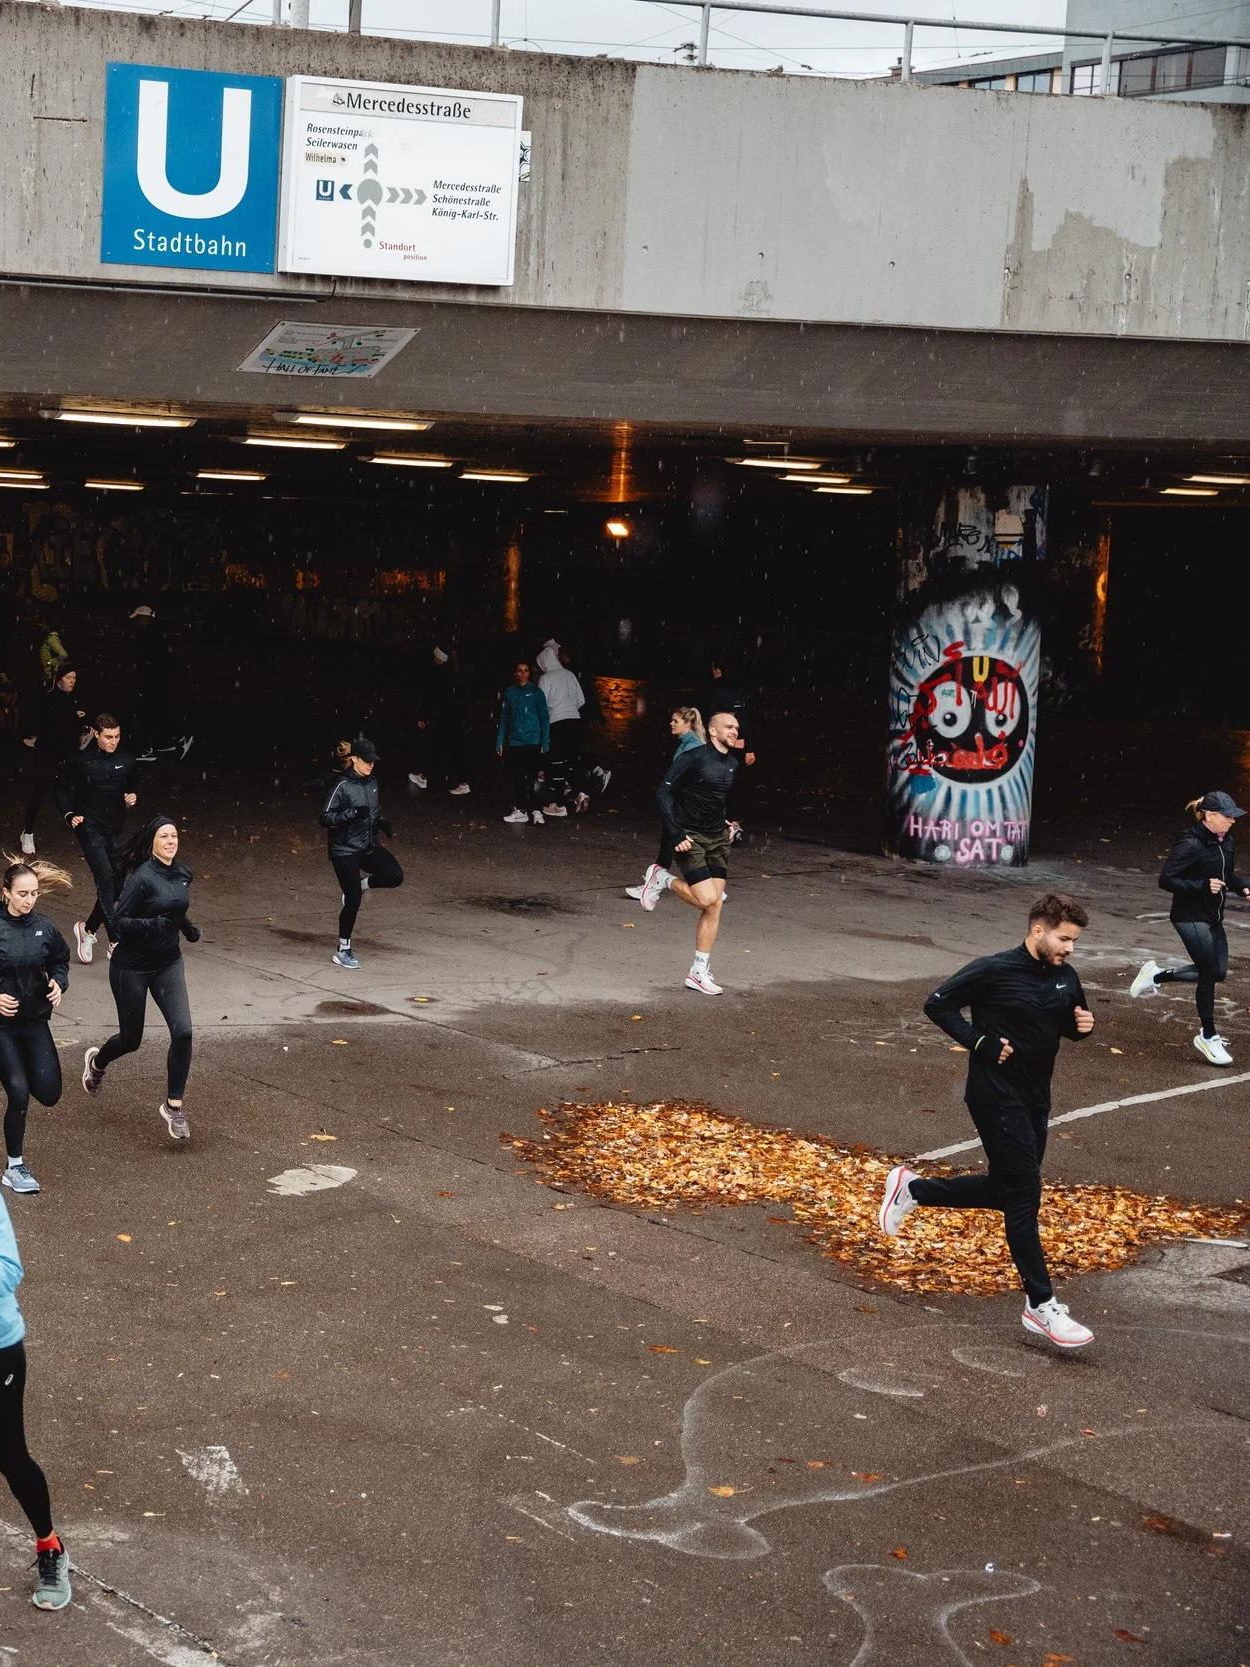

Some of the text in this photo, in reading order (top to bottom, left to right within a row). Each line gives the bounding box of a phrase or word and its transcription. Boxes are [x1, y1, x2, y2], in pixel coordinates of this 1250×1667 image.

[347, 92, 471, 119] Mercedesstraße
[137, 80, 252, 219] U
[306, 137, 358, 150] Seilerwasen
[305, 152, 337, 163] Wilhelma
[318, 180, 332, 197] U
[433, 180, 502, 194] Mercedesstraße
[432, 194, 491, 207] Schönestraße
[432, 207, 499, 221] König-Karl-Str.
[133, 228, 247, 257] Stadtbahn
[379, 241, 416, 252] Standort
[909, 815, 959, 842] HARI
[970, 820, 1000, 838] OM
[956, 838, 1005, 864] SAT
